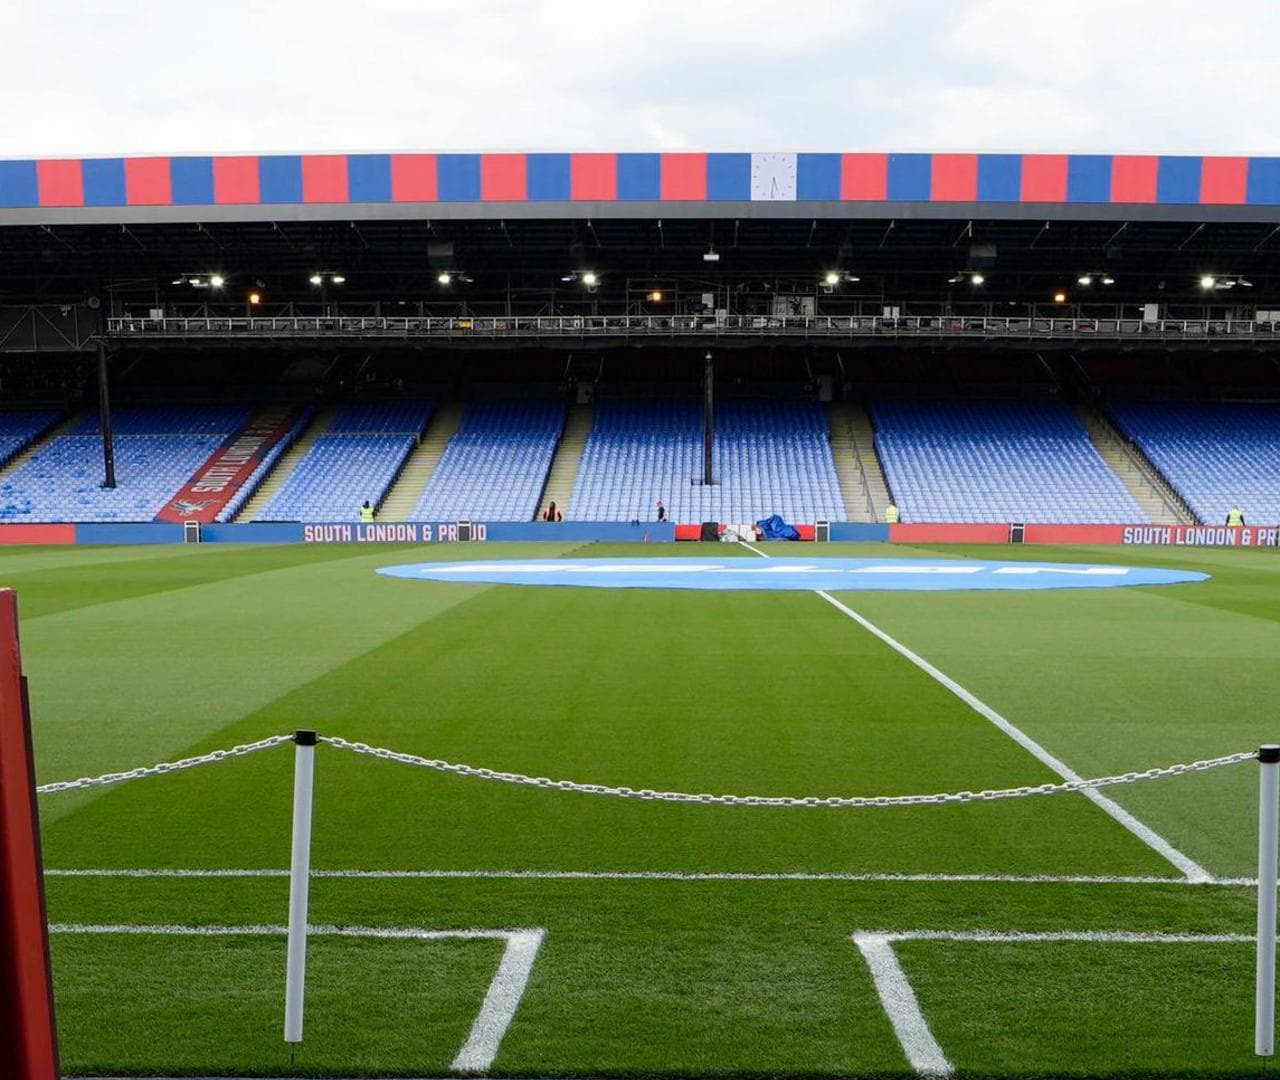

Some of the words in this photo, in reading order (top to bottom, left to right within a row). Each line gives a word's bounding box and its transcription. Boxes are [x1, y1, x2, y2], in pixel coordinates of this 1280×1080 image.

[304, 525, 351, 542] SOUTH
[356, 524, 417, 542] LONDON
[422, 525, 432, 542] &
[1123, 527, 1170, 545] SOUTH
[1176, 528, 1235, 545] LONDON
[1241, 529, 1251, 545] &
